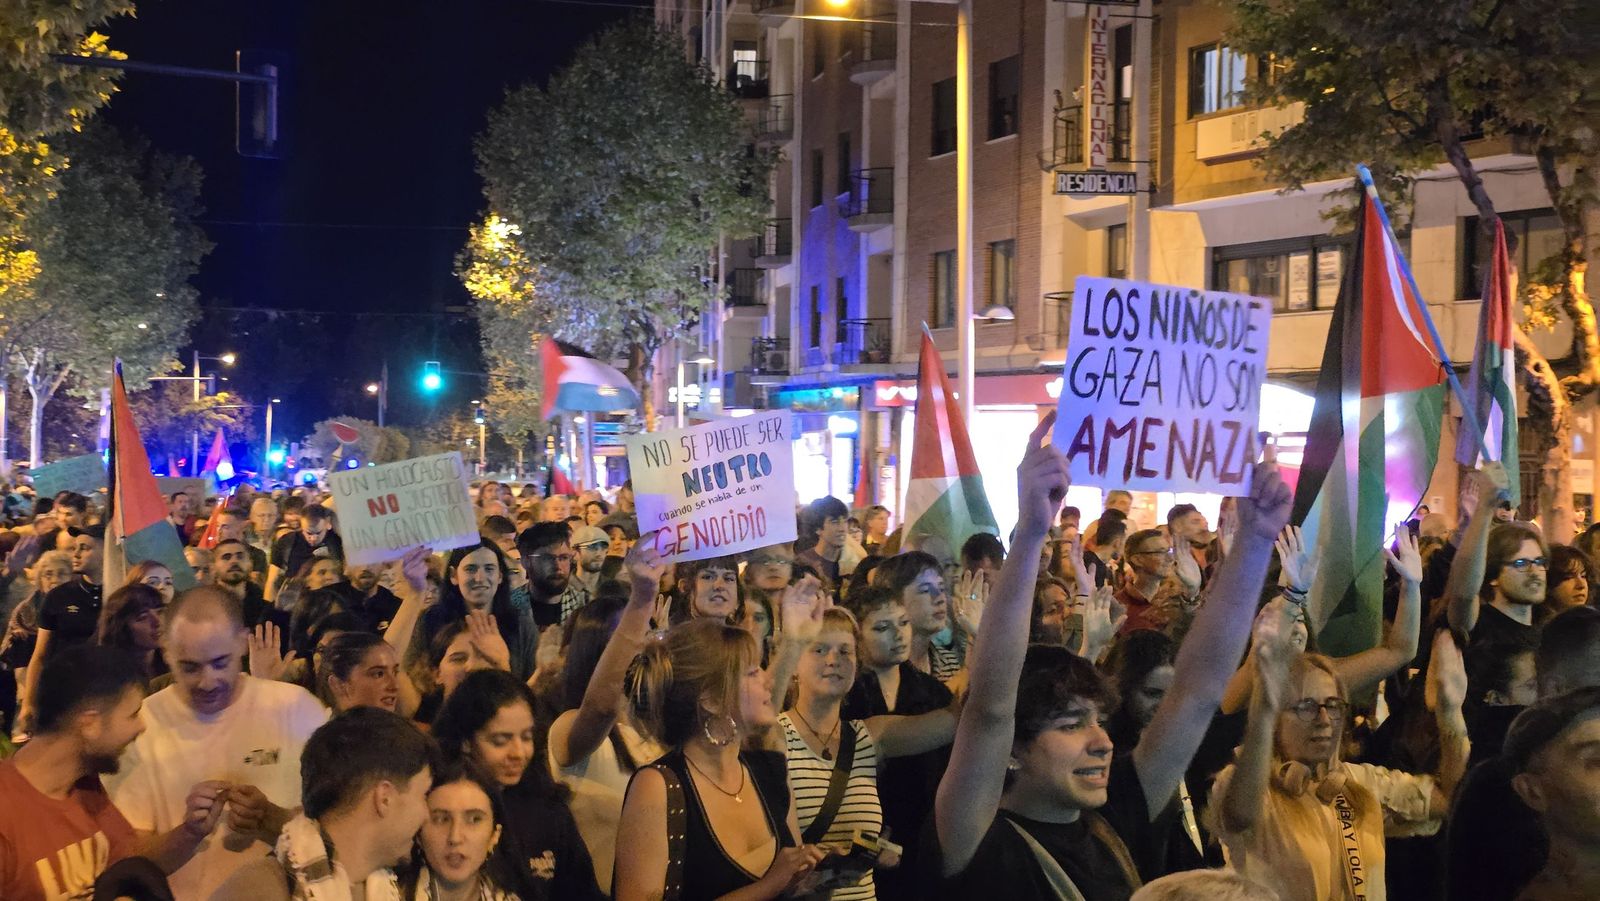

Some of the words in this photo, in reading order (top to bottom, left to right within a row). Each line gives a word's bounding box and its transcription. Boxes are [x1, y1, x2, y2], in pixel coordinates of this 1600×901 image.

[1090, 6, 1107, 168] INTERNACIONAL
[1057, 174, 1137, 193] RESIDENCIA
[1083, 287, 1140, 342] LOS
[1149, 289, 1229, 349] NIÑOS
[1069, 346, 1163, 406] GAZA
[1177, 350, 1218, 410] NO
[643, 439, 673, 468] NO
[680, 434, 699, 463] SE
[705, 424, 752, 457] PUEDE
[758, 416, 785, 445] SER
[1066, 414, 1257, 484] AMENAZA
[338, 473, 370, 497] UN
[681, 451, 772, 498] NEUTRO
[367, 493, 400, 518] NO
[695, 499, 706, 510] se
[708, 489, 733, 505] habla
[735, 484, 747, 496] de
[350, 526, 377, 550] UN
[1344, 832, 1356, 842] Y
[1347, 847, 1364, 887] LOLA
